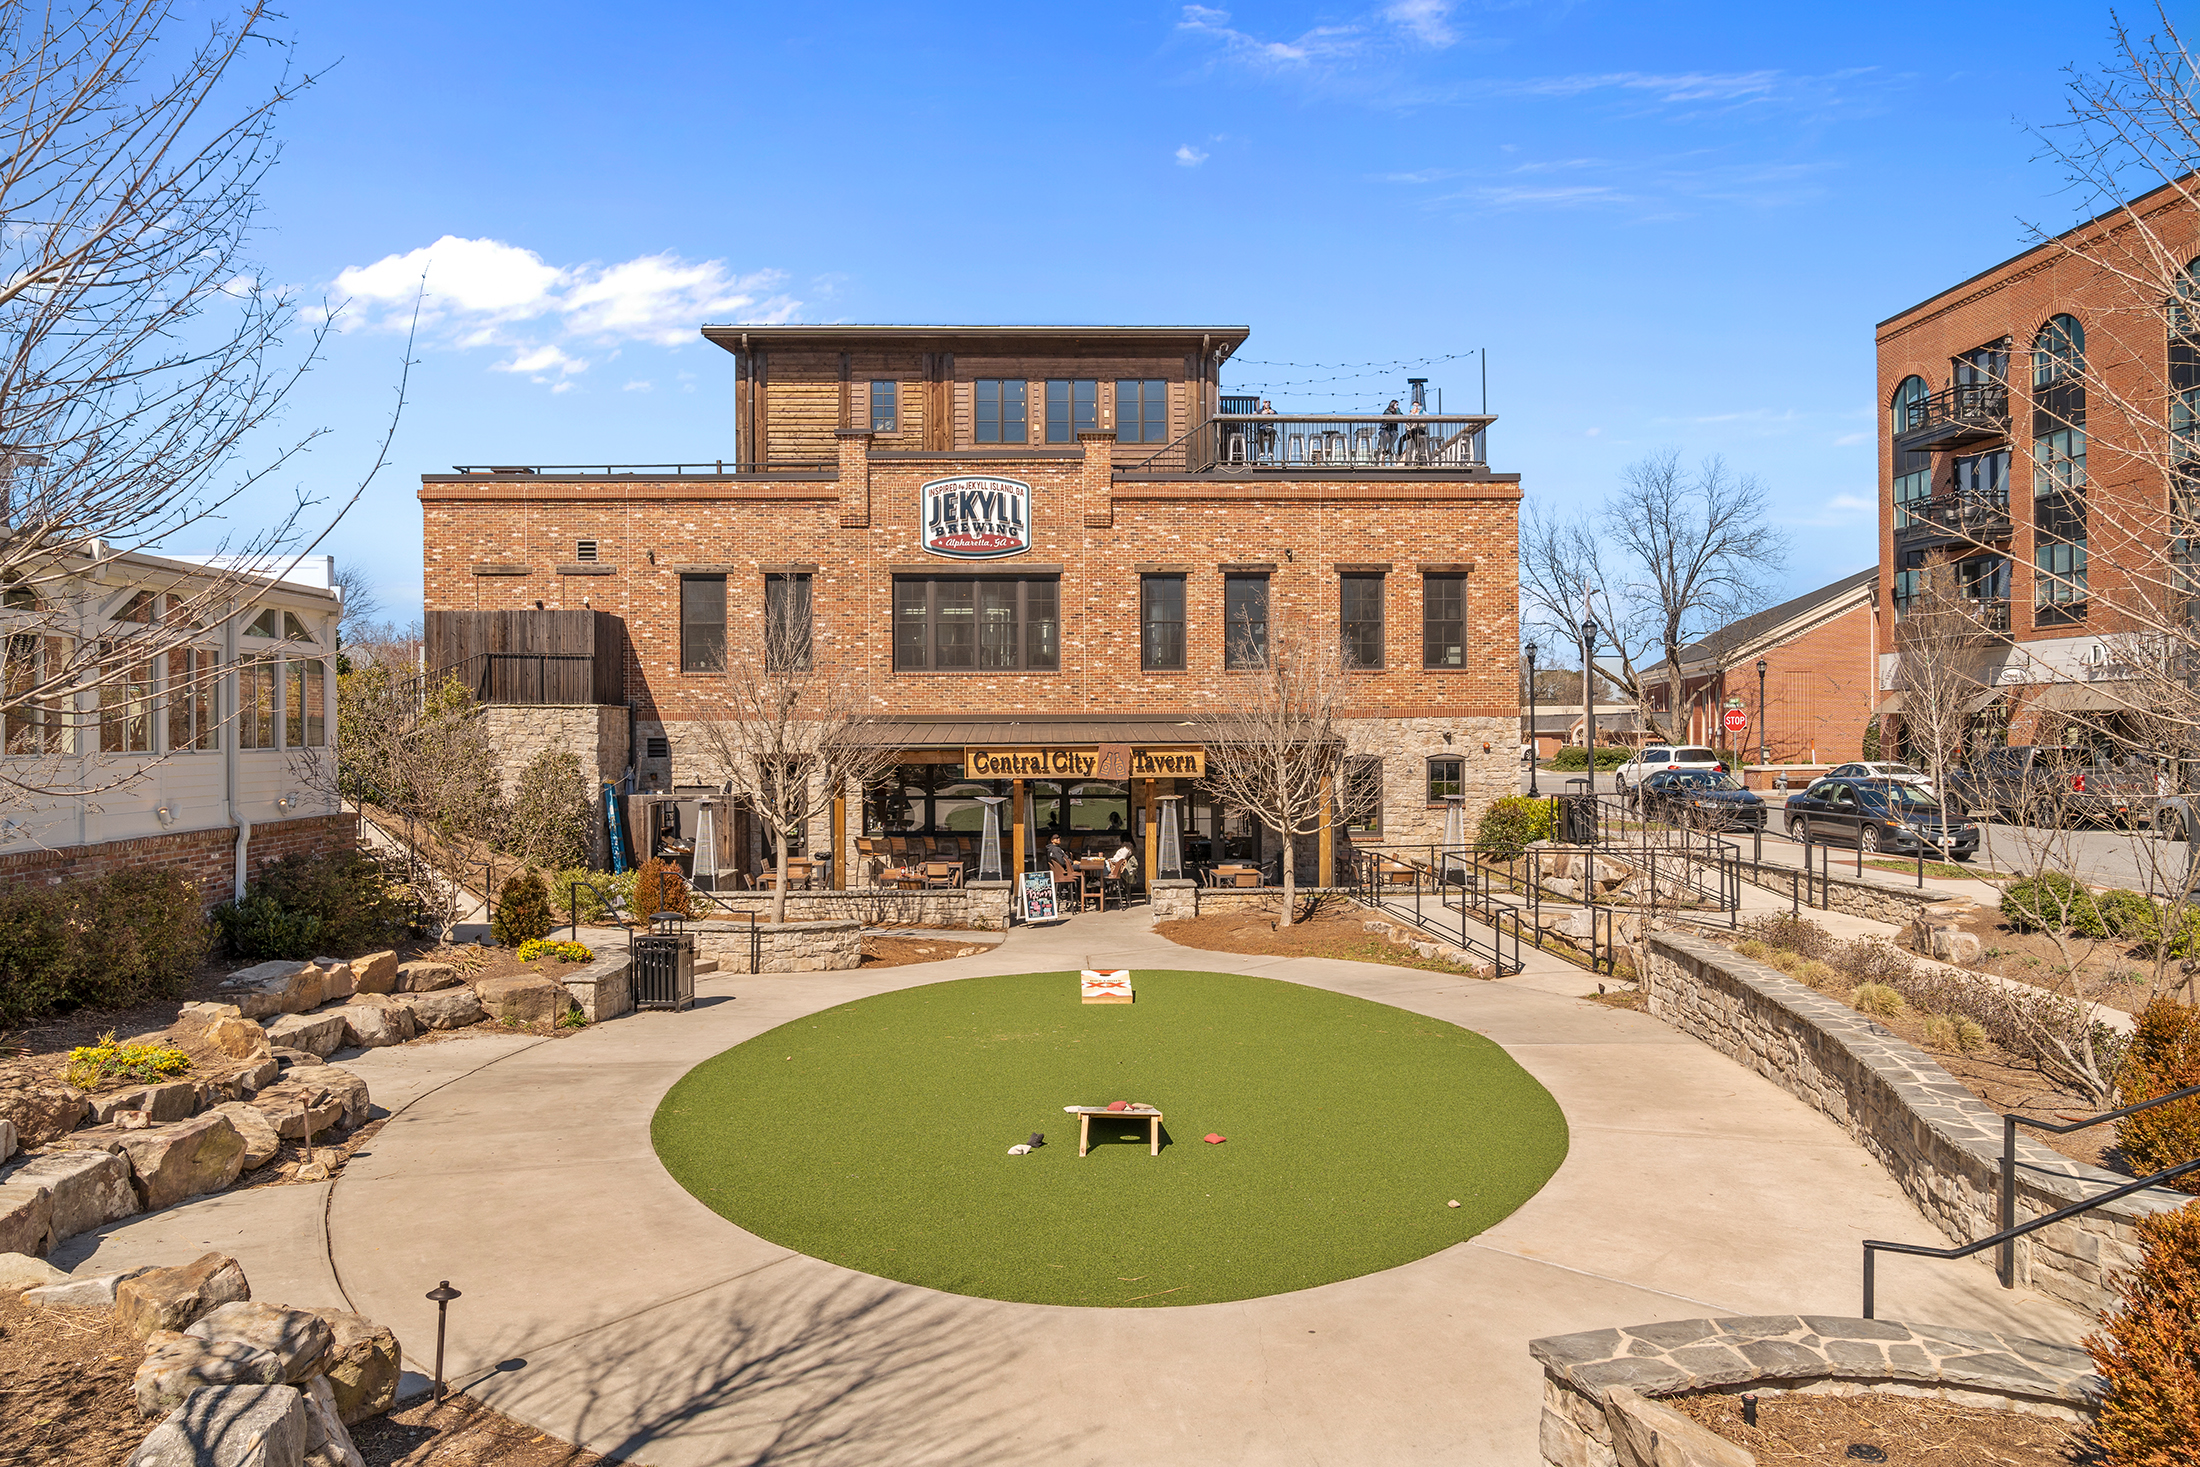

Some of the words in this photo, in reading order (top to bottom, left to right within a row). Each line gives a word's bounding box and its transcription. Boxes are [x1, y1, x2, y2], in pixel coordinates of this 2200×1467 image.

[928, 483, 957, 497] INSPIRED
[965, 482, 988, 490] JEKYLL
[1016, 487, 1025, 497] GA
[929, 491, 1023, 529] JEKYLL
[935, 522, 1018, 537] BREWING
[993, 538, 1007, 548] GA
[1725, 716, 1745, 725] STOP
[973, 750, 1050, 775] Central
[1052, 751, 1096, 778] City
[1133, 750, 1198, 773] Tavern
